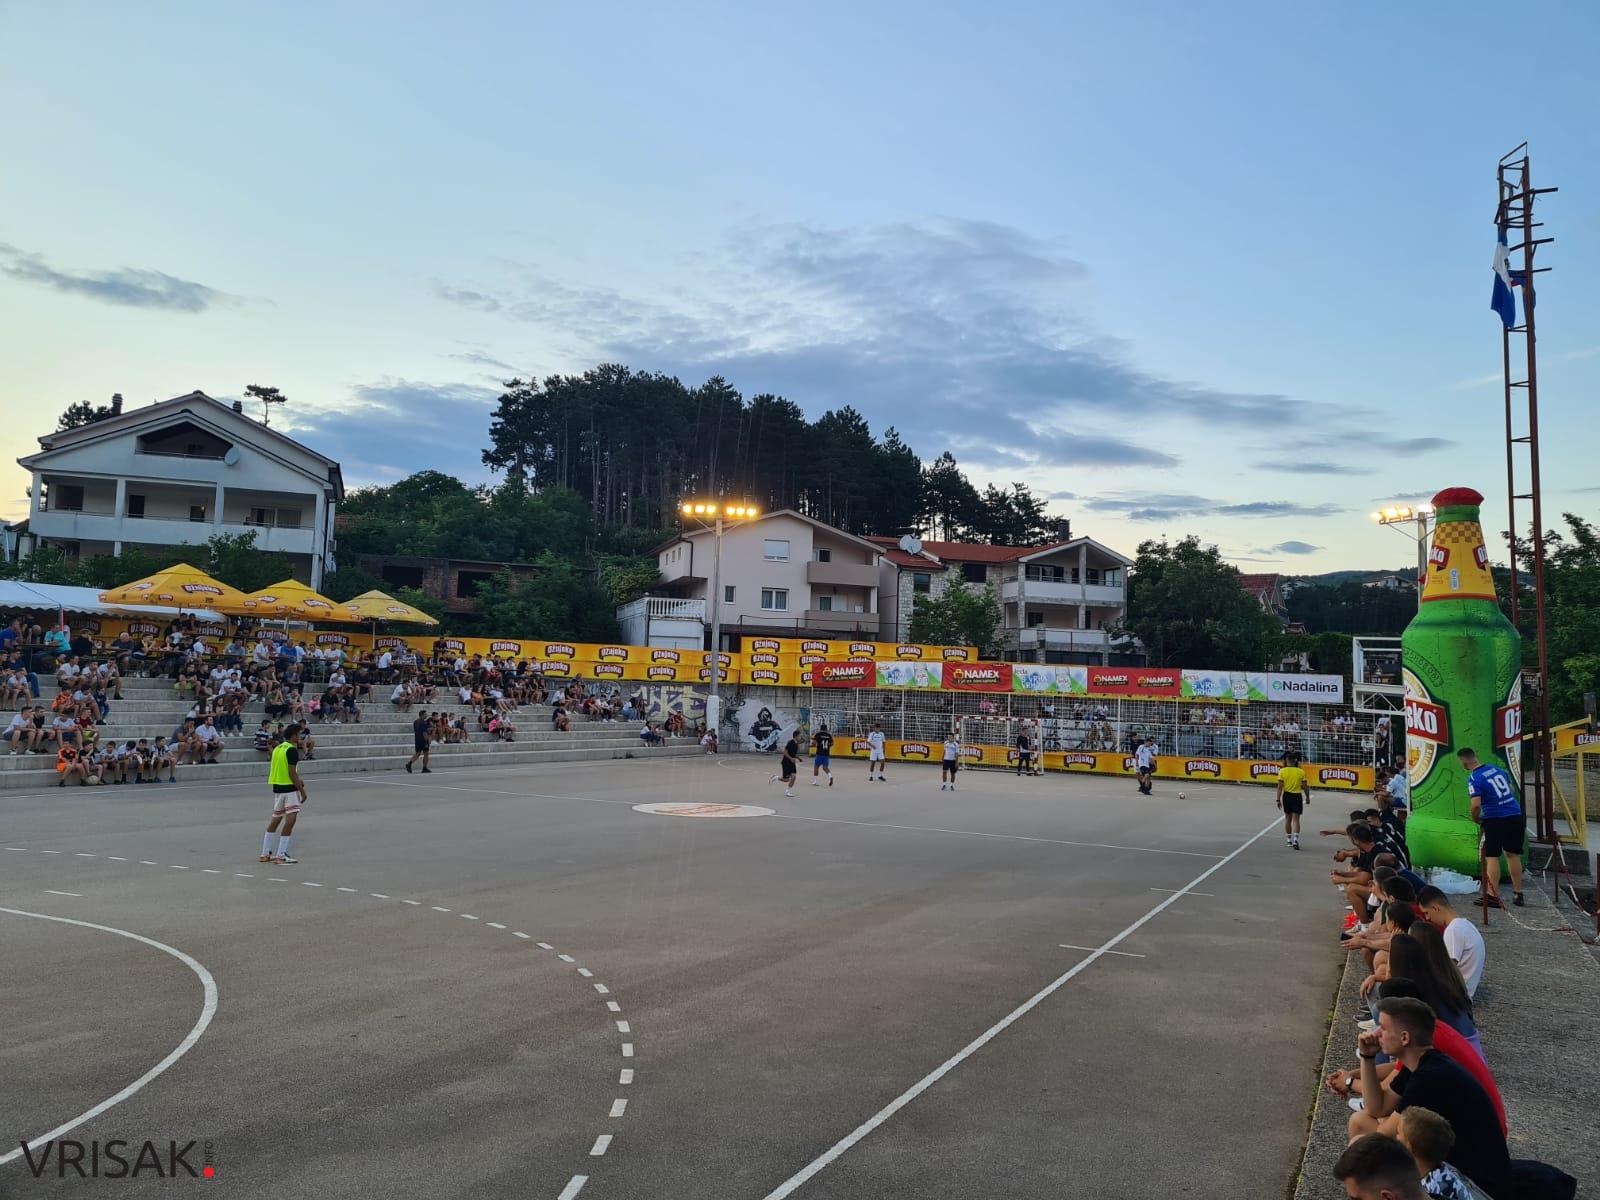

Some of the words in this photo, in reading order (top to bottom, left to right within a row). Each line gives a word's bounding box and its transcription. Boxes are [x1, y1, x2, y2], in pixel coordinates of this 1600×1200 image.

[832, 666, 865, 676] NAMEX
[964, 669, 1000, 679] NAMEX
[1146, 676, 1174, 684] NAMEX
[1282, 680, 1338, 693] Nadalina
[1487, 774, 1510, 799] 19
